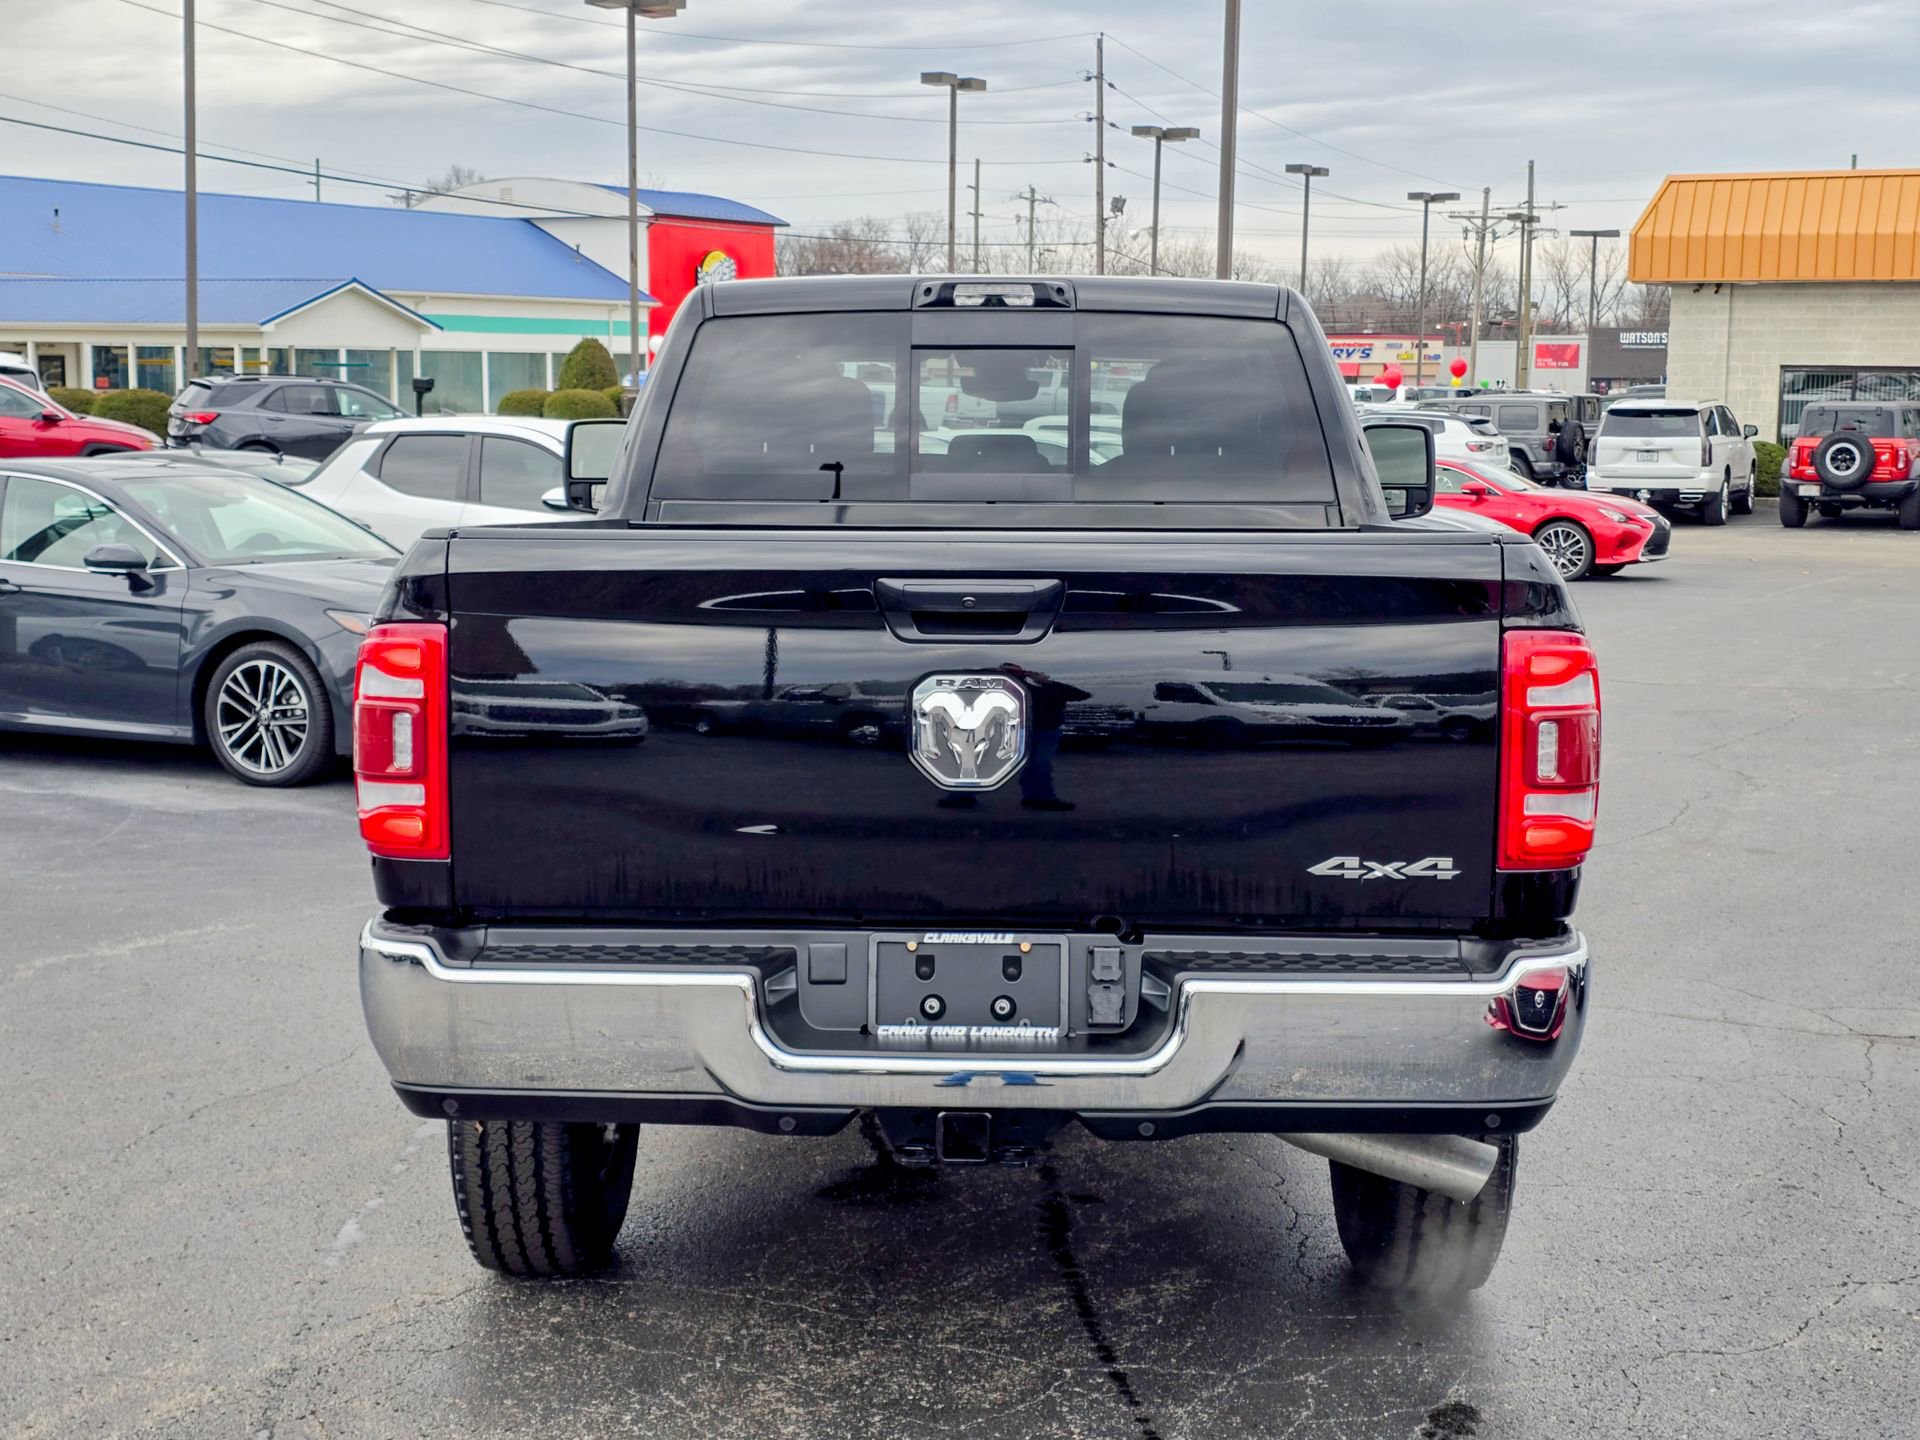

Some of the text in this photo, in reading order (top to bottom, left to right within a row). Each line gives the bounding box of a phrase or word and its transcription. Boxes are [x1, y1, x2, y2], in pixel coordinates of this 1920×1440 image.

[1620, 332, 1668, 344] WATSON'S
[1332, 348, 1373, 359] RV'S
[935, 678, 1004, 689] RAM
[923, 932, 1015, 944] CLARKSVILLE
[877, 1025, 1059, 1038] CRAIG AND LANDRETH
